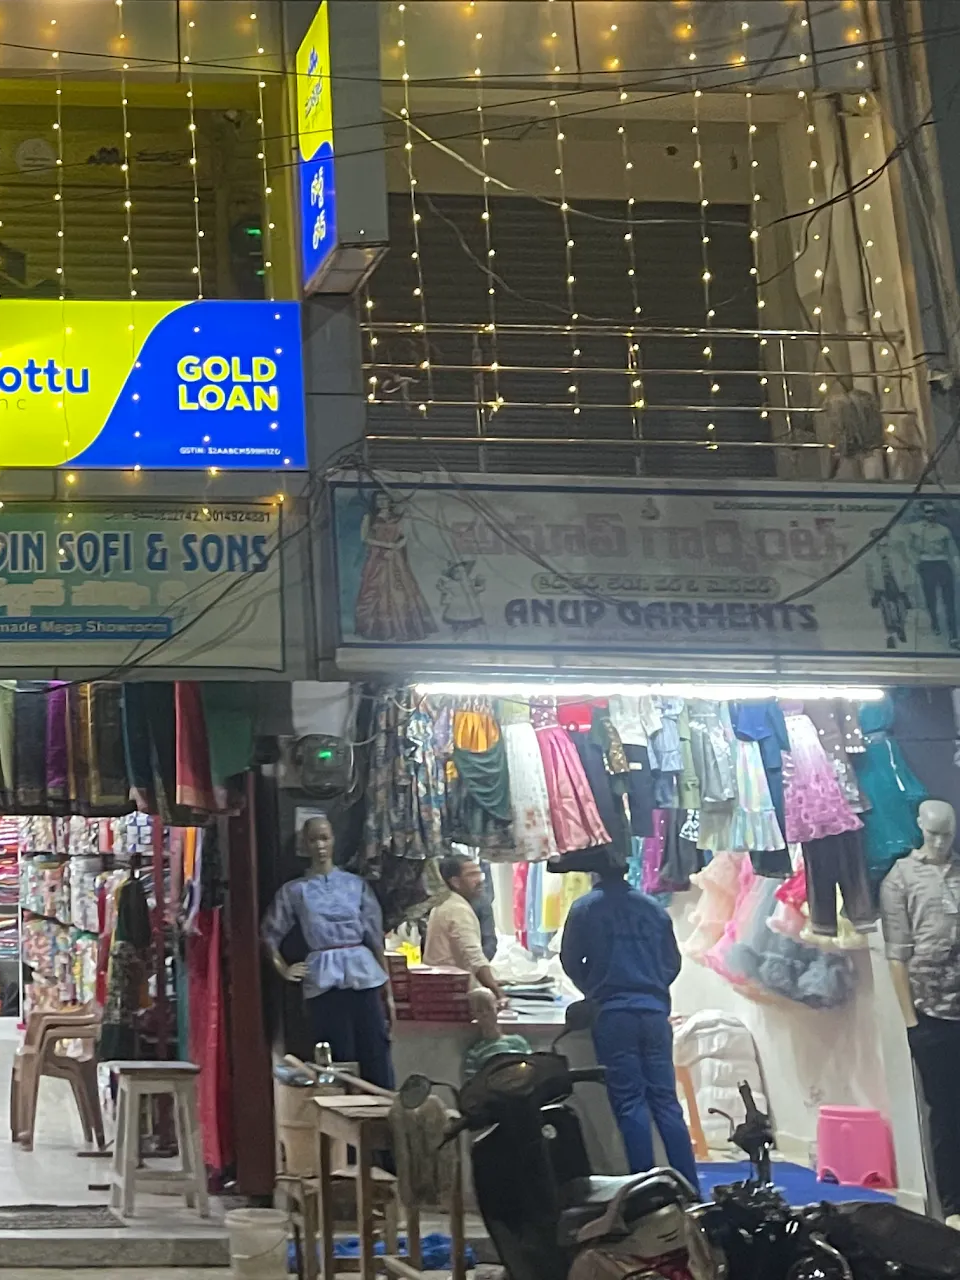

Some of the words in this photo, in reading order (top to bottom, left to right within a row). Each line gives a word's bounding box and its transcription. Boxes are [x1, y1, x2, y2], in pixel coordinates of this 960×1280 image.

[177, 355, 277, 382] GOLD
[178, 384, 279, 411] LOAN
[57, 531, 133, 576] SOFI
[145, 532, 169, 573] &
[180, 532, 270, 574] SONS
[504, 598, 607, 628] ANUP
[617, 600, 820, 632] GARMENTS
